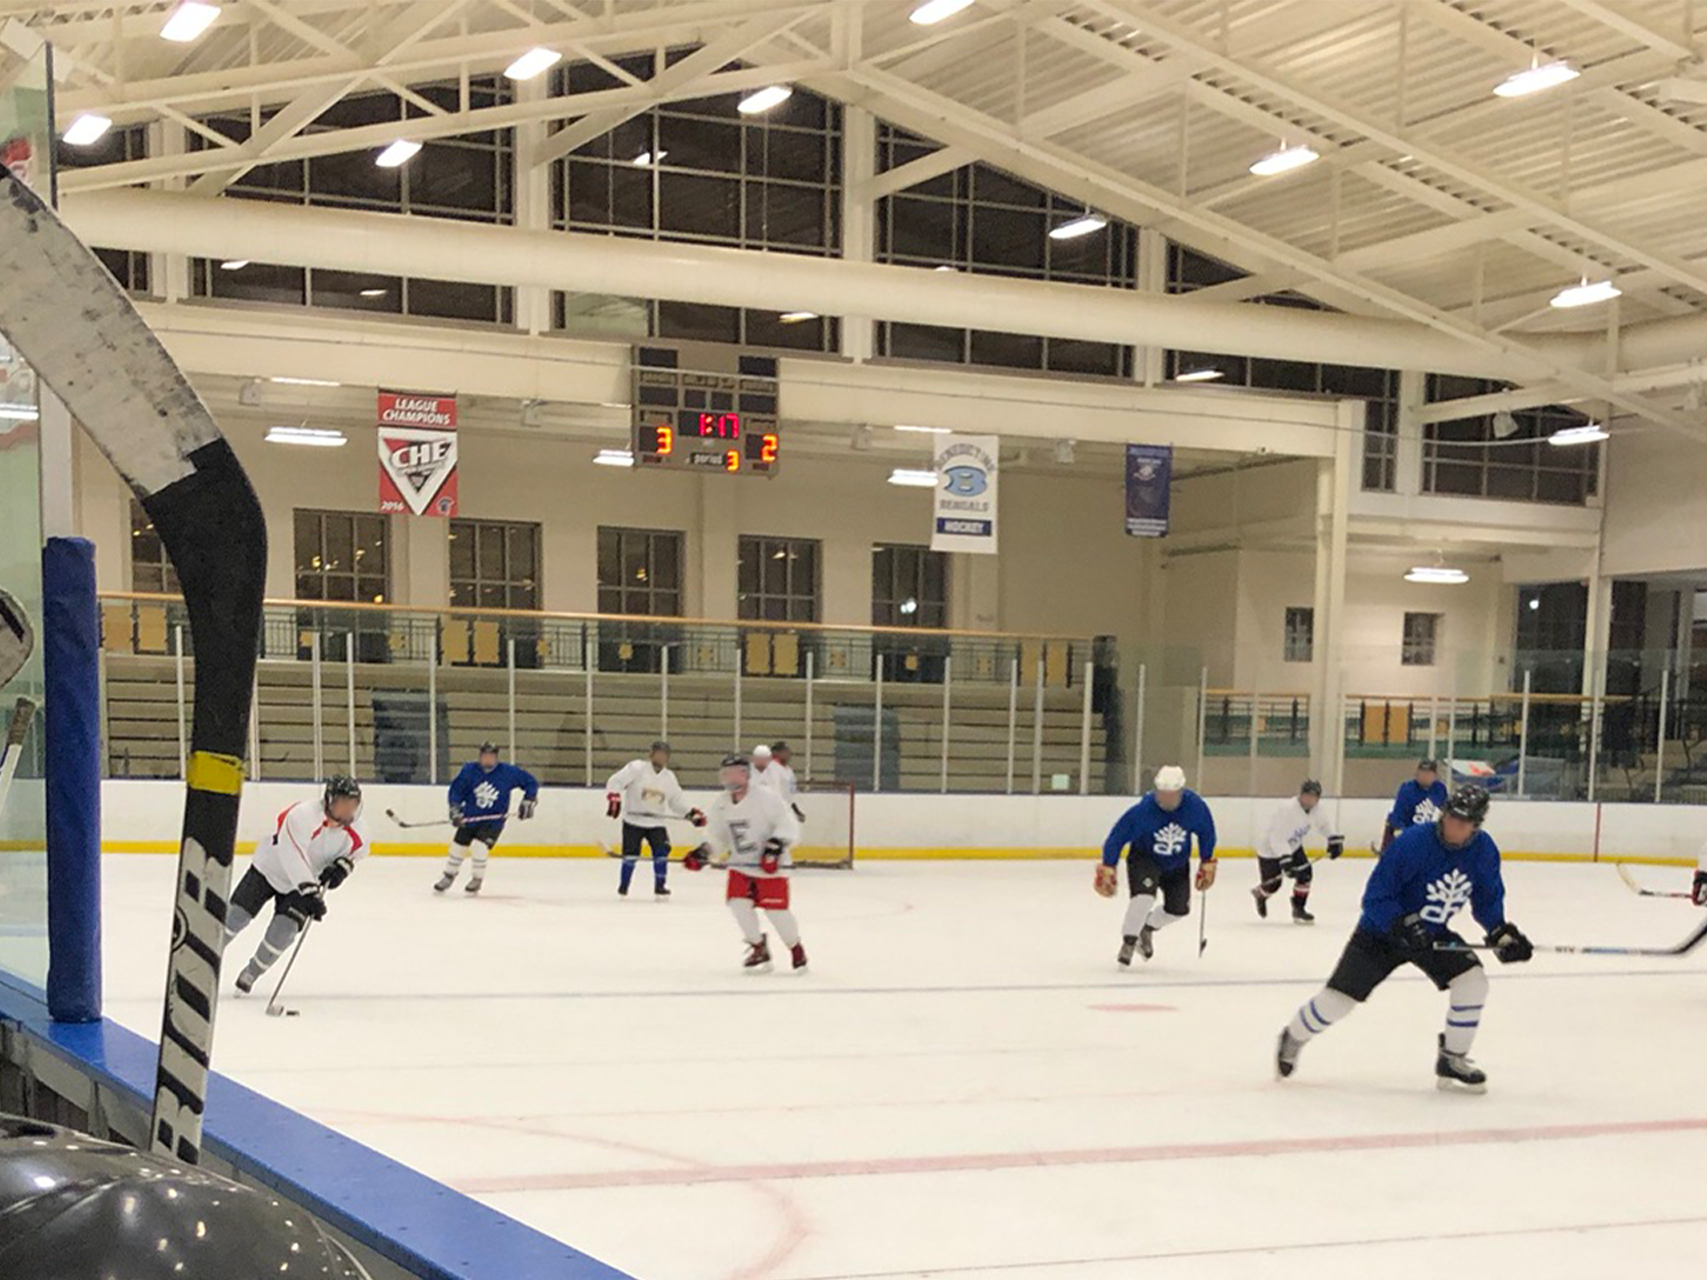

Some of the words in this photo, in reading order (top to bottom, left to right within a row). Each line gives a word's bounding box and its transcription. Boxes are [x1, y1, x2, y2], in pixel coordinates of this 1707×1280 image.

[395, 398, 438, 412] LEAGUE
[382, 409, 450, 425] CHAMPIONS
[656, 426, 672, 454] 3
[761, 433, 777, 462] 2
[726, 449, 739, 472] 3
